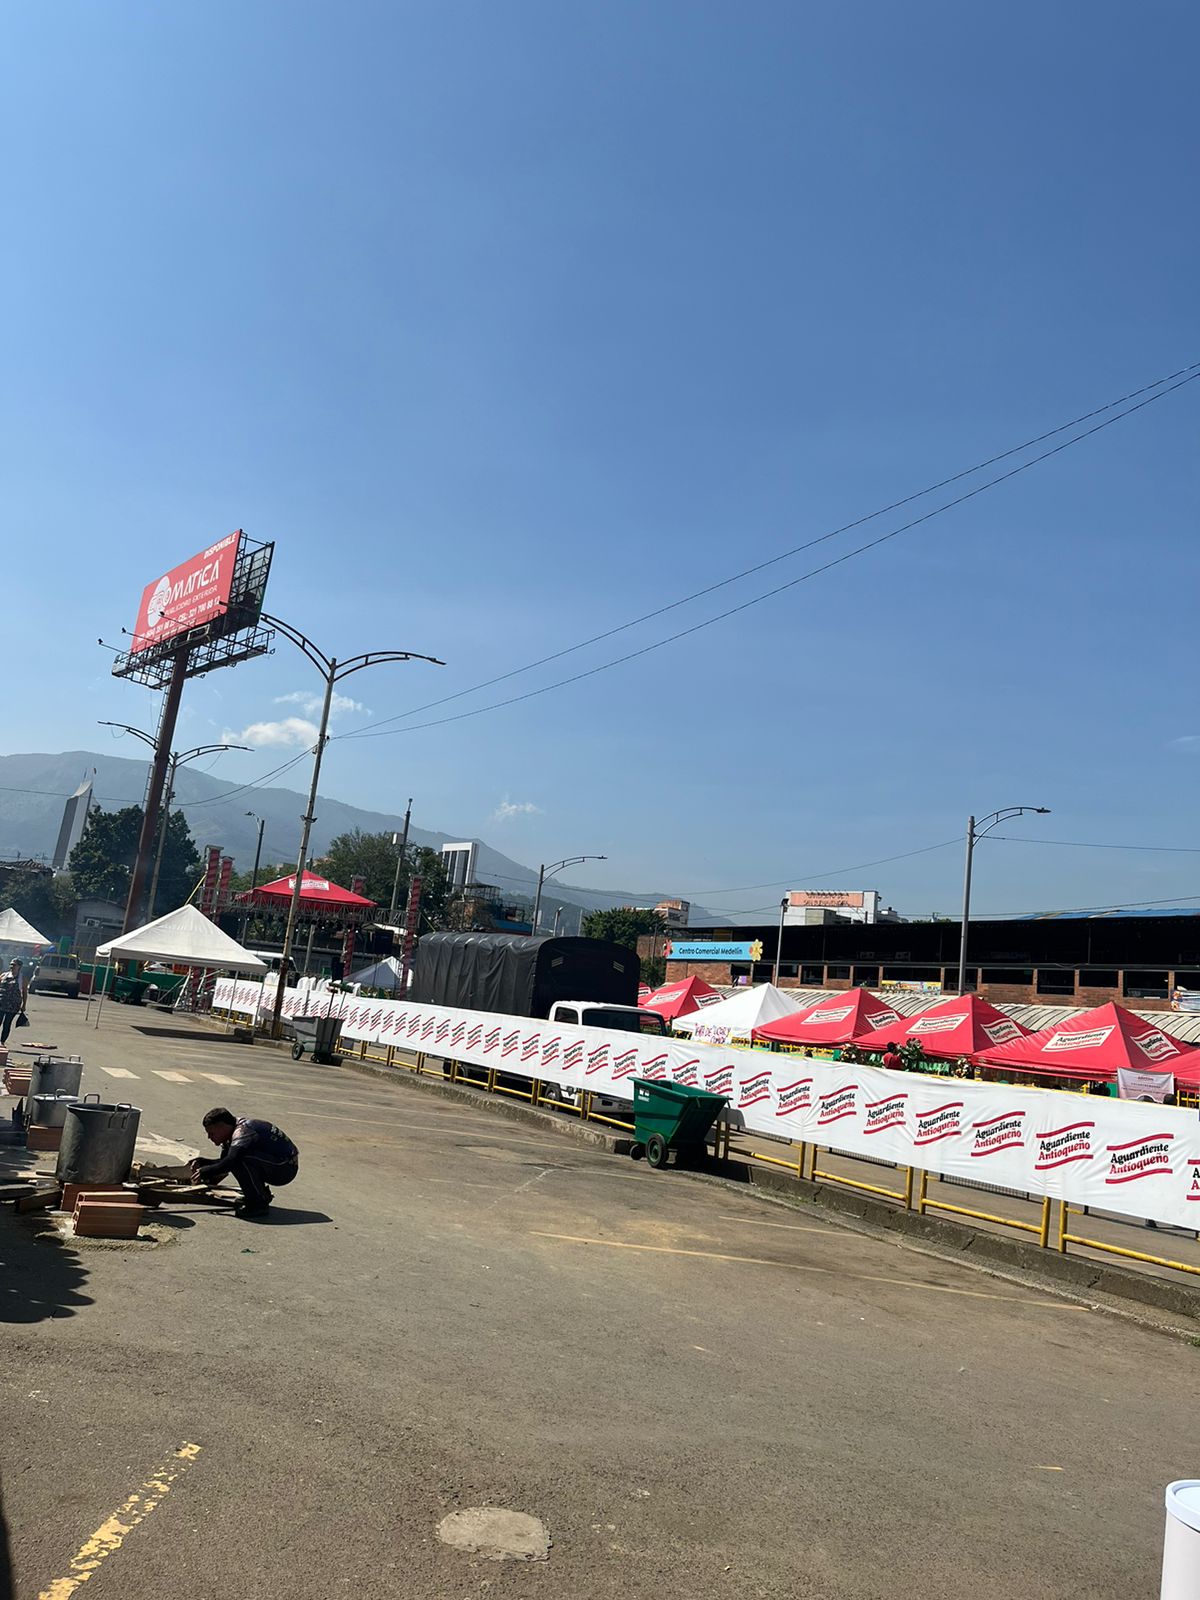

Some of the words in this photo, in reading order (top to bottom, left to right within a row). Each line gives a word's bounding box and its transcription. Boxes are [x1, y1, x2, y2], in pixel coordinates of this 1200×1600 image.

[204, 533, 237, 559] DISPONIBLE
[695, 947, 720, 955] Comercial
[720, 947, 743, 955] Medellín
[741, 1078, 769, 1094] Aguardiente
[779, 1085, 810, 1102] Aguardiente
[778, 1093, 810, 1109] Antioqueño
[820, 1099, 855, 1117] Antioqueño
[821, 1092, 855, 1109] Aguardiente
[867, 1101, 905, 1118] Aguardiente
[866, 1108, 904, 1126] Antioqueño
[918, 1110, 960, 1129] Aguardiente
[917, 1118, 960, 1137] Antioqueño
[975, 1120, 1022, 1139] Aguardiente
[974, 1128, 1021, 1148] Antioqueño
[1040, 1131, 1090, 1151] Aguardiente
[1038, 1140, 1090, 1161] Antioqueño
[1111, 1143, 1169, 1165] Aguardiente
[1110, 1152, 1169, 1174] Antioqueño
